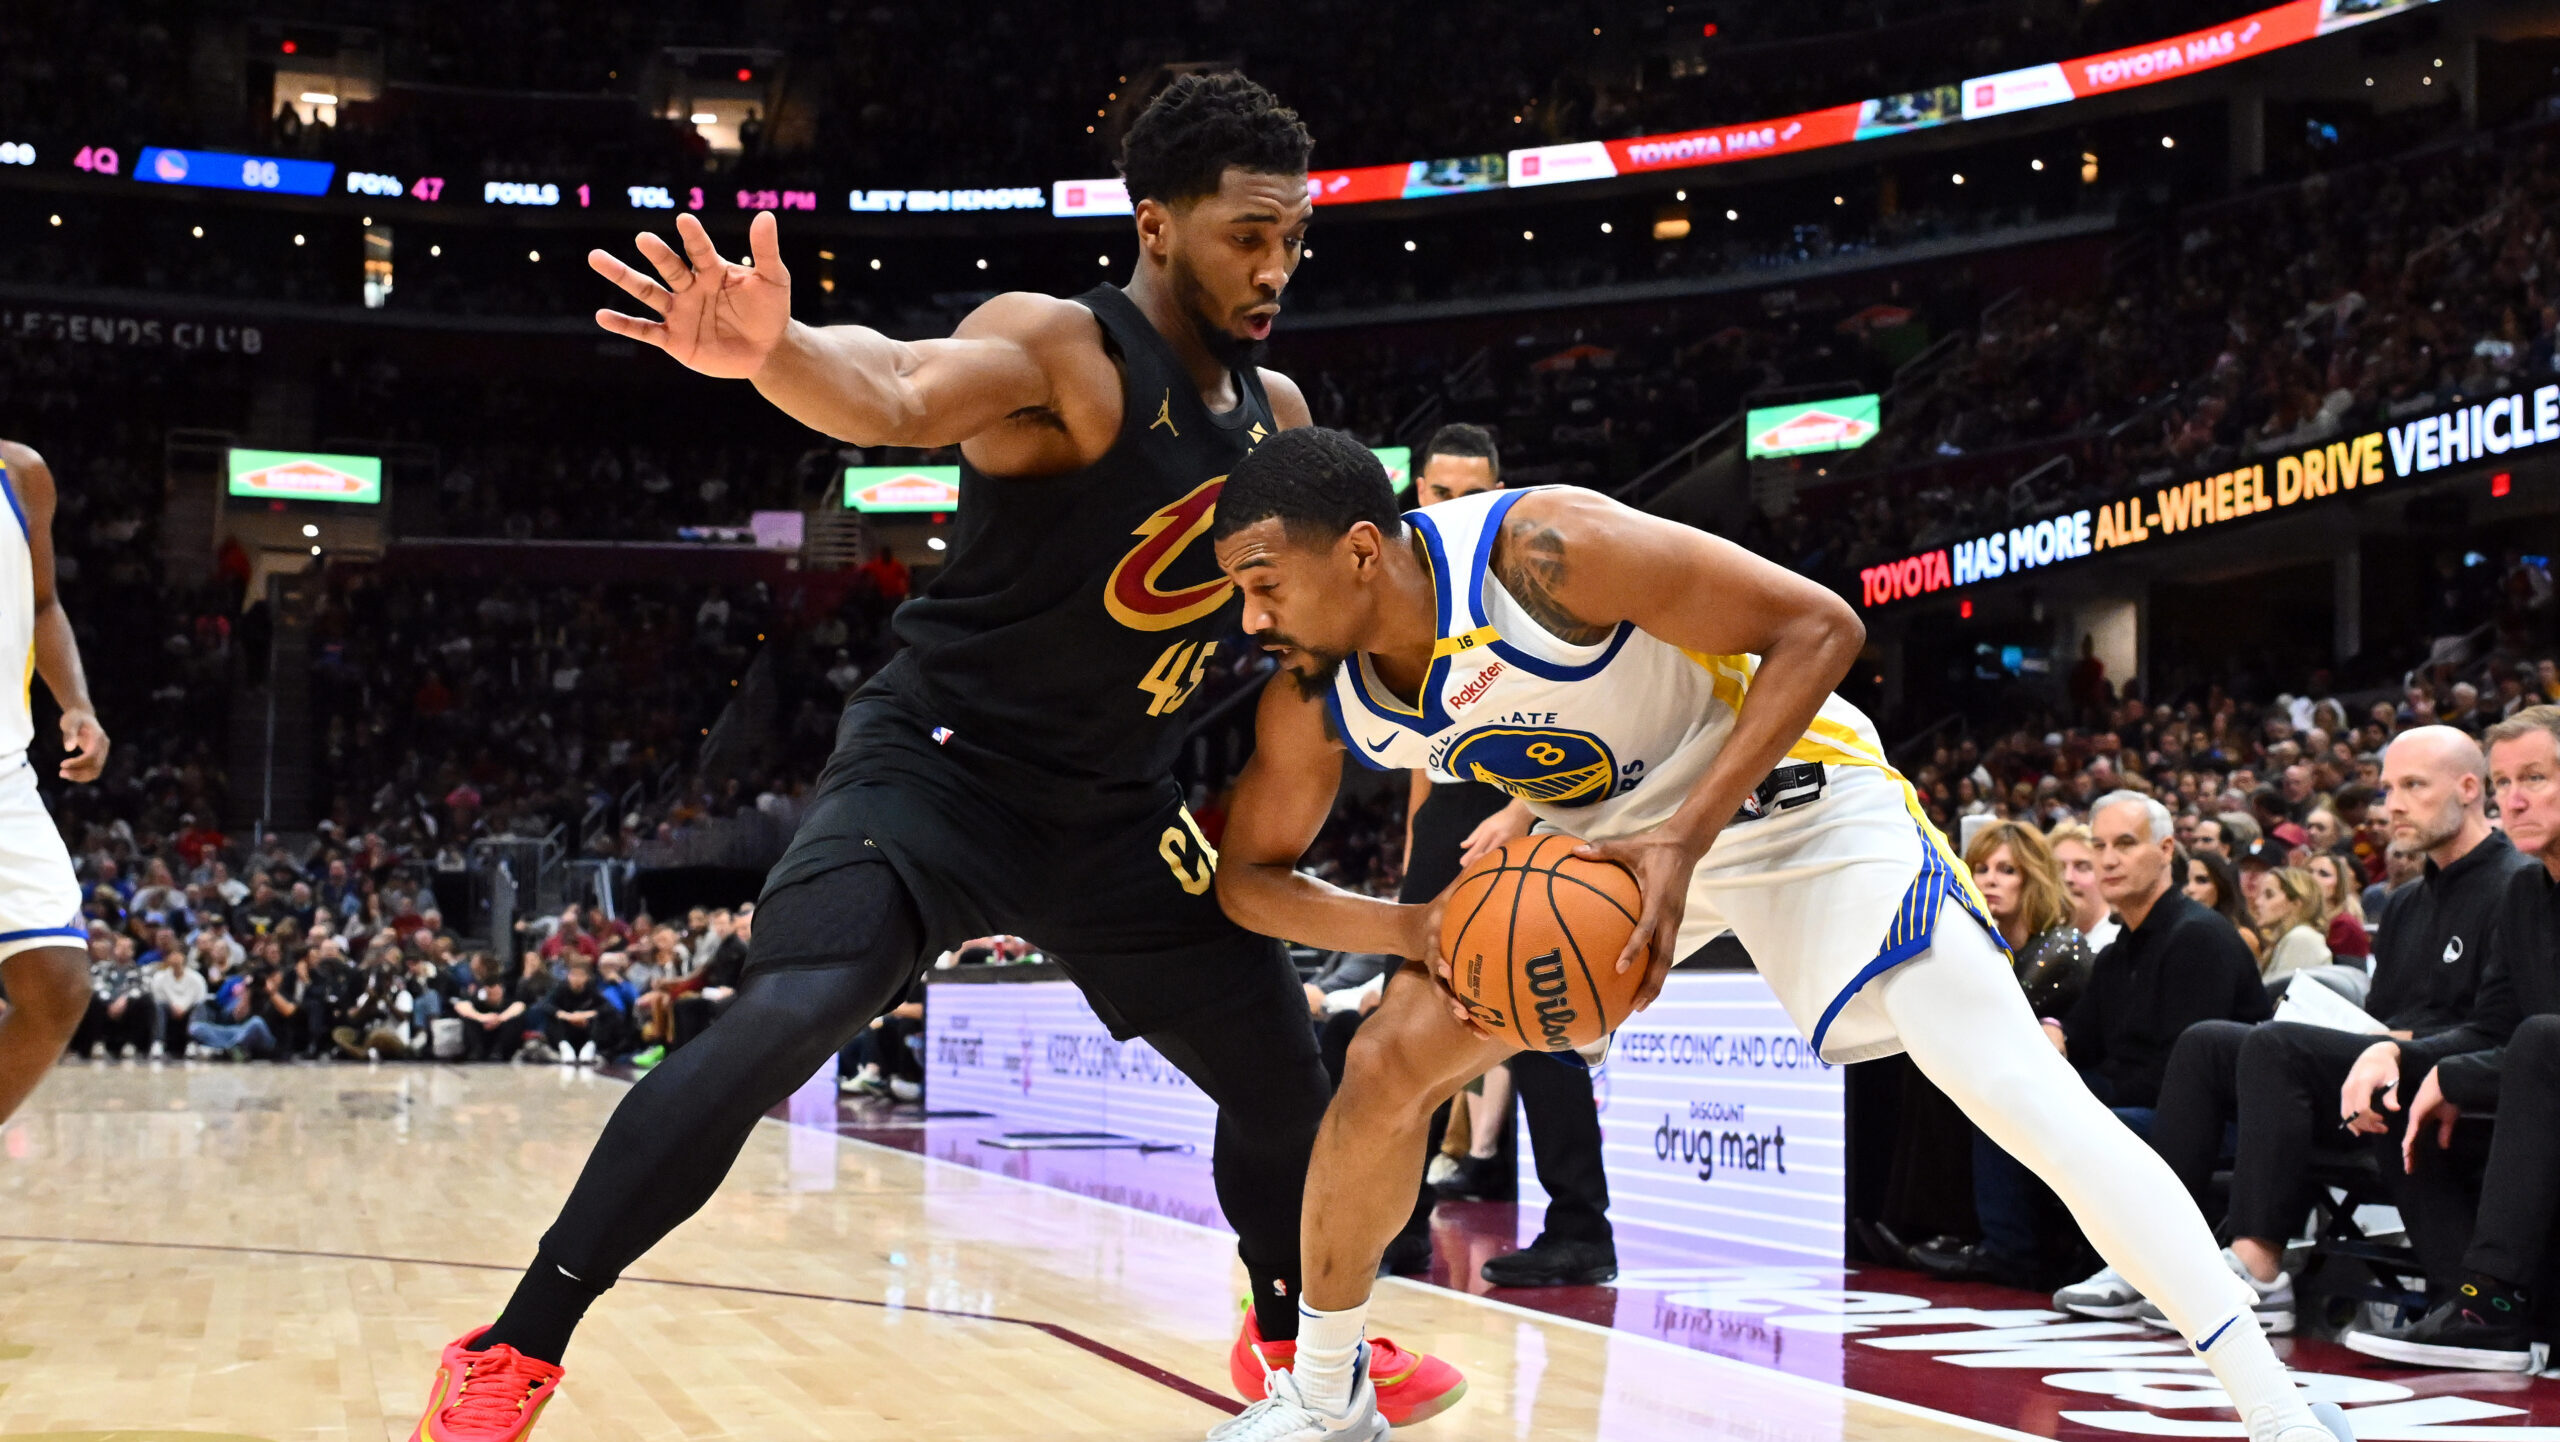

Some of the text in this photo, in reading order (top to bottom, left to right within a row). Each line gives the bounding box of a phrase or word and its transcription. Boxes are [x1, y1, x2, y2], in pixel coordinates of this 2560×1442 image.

[2085, 30, 2236, 87] TOYOTA HAS
[73, 145, 119, 175] 4Q
[1627, 127, 1776, 165] TOYOTA HAS
[347, 171, 704, 211] FG% 47 FOULS 1 TOL 3
[782, 190, 816, 211] PM
[850, 190, 906, 212] LET
[1860, 549, 1952, 607] TOYOTA
[1953, 532, 2006, 586] HAS
[2009, 509, 2092, 573] MORE
[2095, 464, 2273, 552] ALL-WHEEL
[2276, 431, 2385, 508] DRIVE
[1457, 635, 1474, 650] 16
[1136, 639, 1219, 717] 45
[1449, 661, 1507, 710] Rakuten
[1526, 742, 1566, 766] 8
[1621, 1033, 1833, 1070] KEEPS GOING AND GOIN
[1690, 1100, 1745, 1122] DISCOUNT
[1655, 1113, 1786, 1181] drug mart
